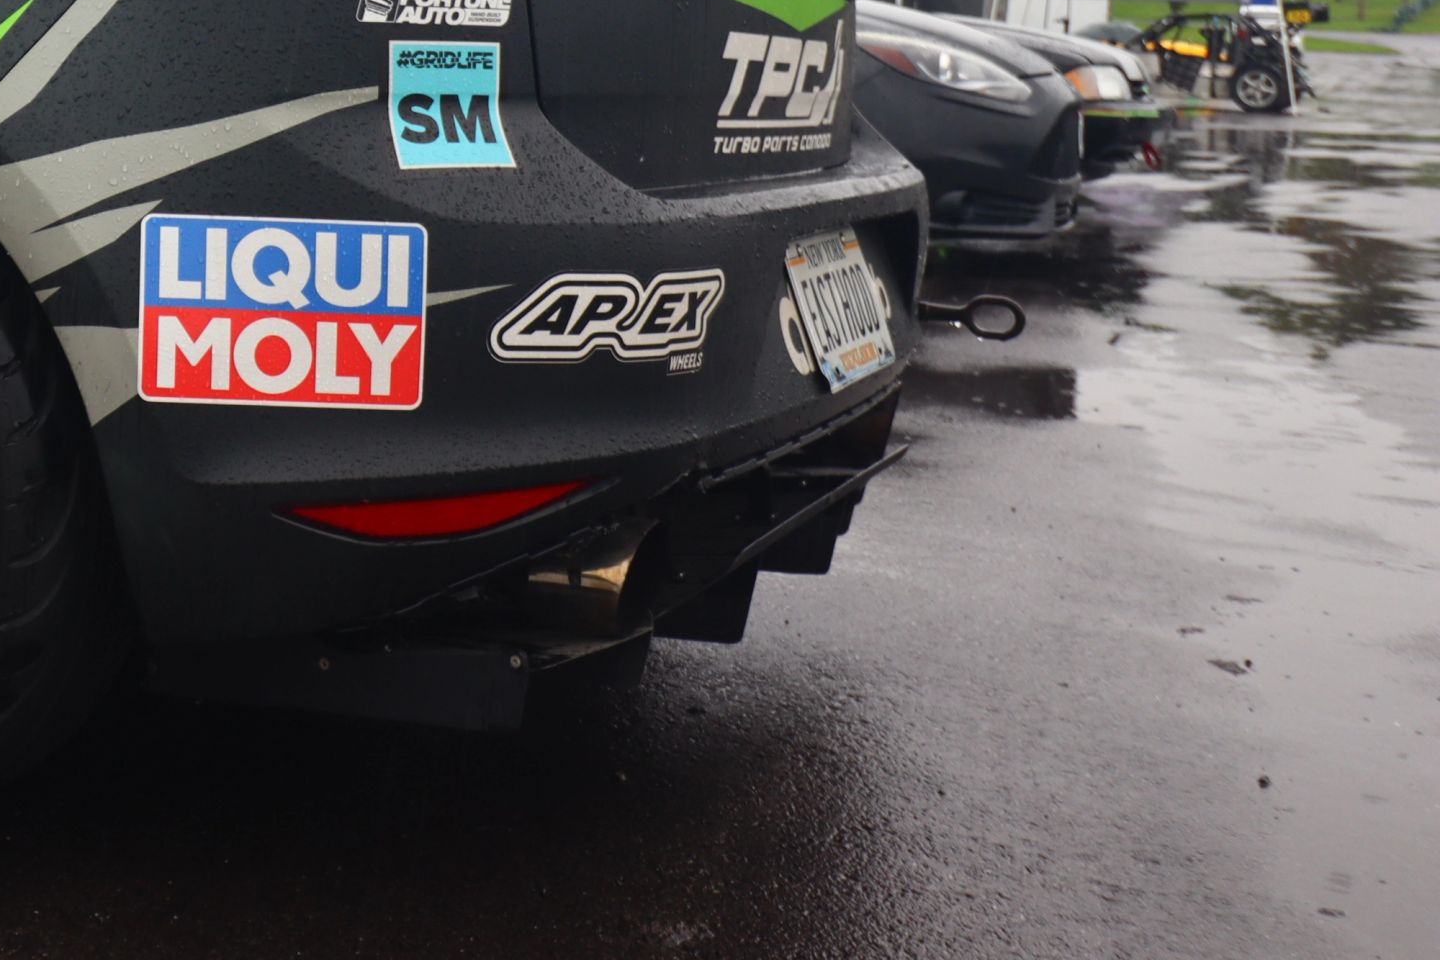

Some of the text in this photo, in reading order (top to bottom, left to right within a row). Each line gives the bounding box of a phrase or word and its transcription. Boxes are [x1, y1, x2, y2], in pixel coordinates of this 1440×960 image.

[396, 6, 466, 27] AUTO
[396, 50, 494, 70] #GRIDLIFE
[397, 93, 498, 144] SM
[157, 225, 409, 311] LIQUI
[517, 290, 712, 337] APEX
[800, 263, 881, 354] EASTHOOD
[155, 316, 420, 398] MOLY
[668, 351, 704, 372] WHEELS
